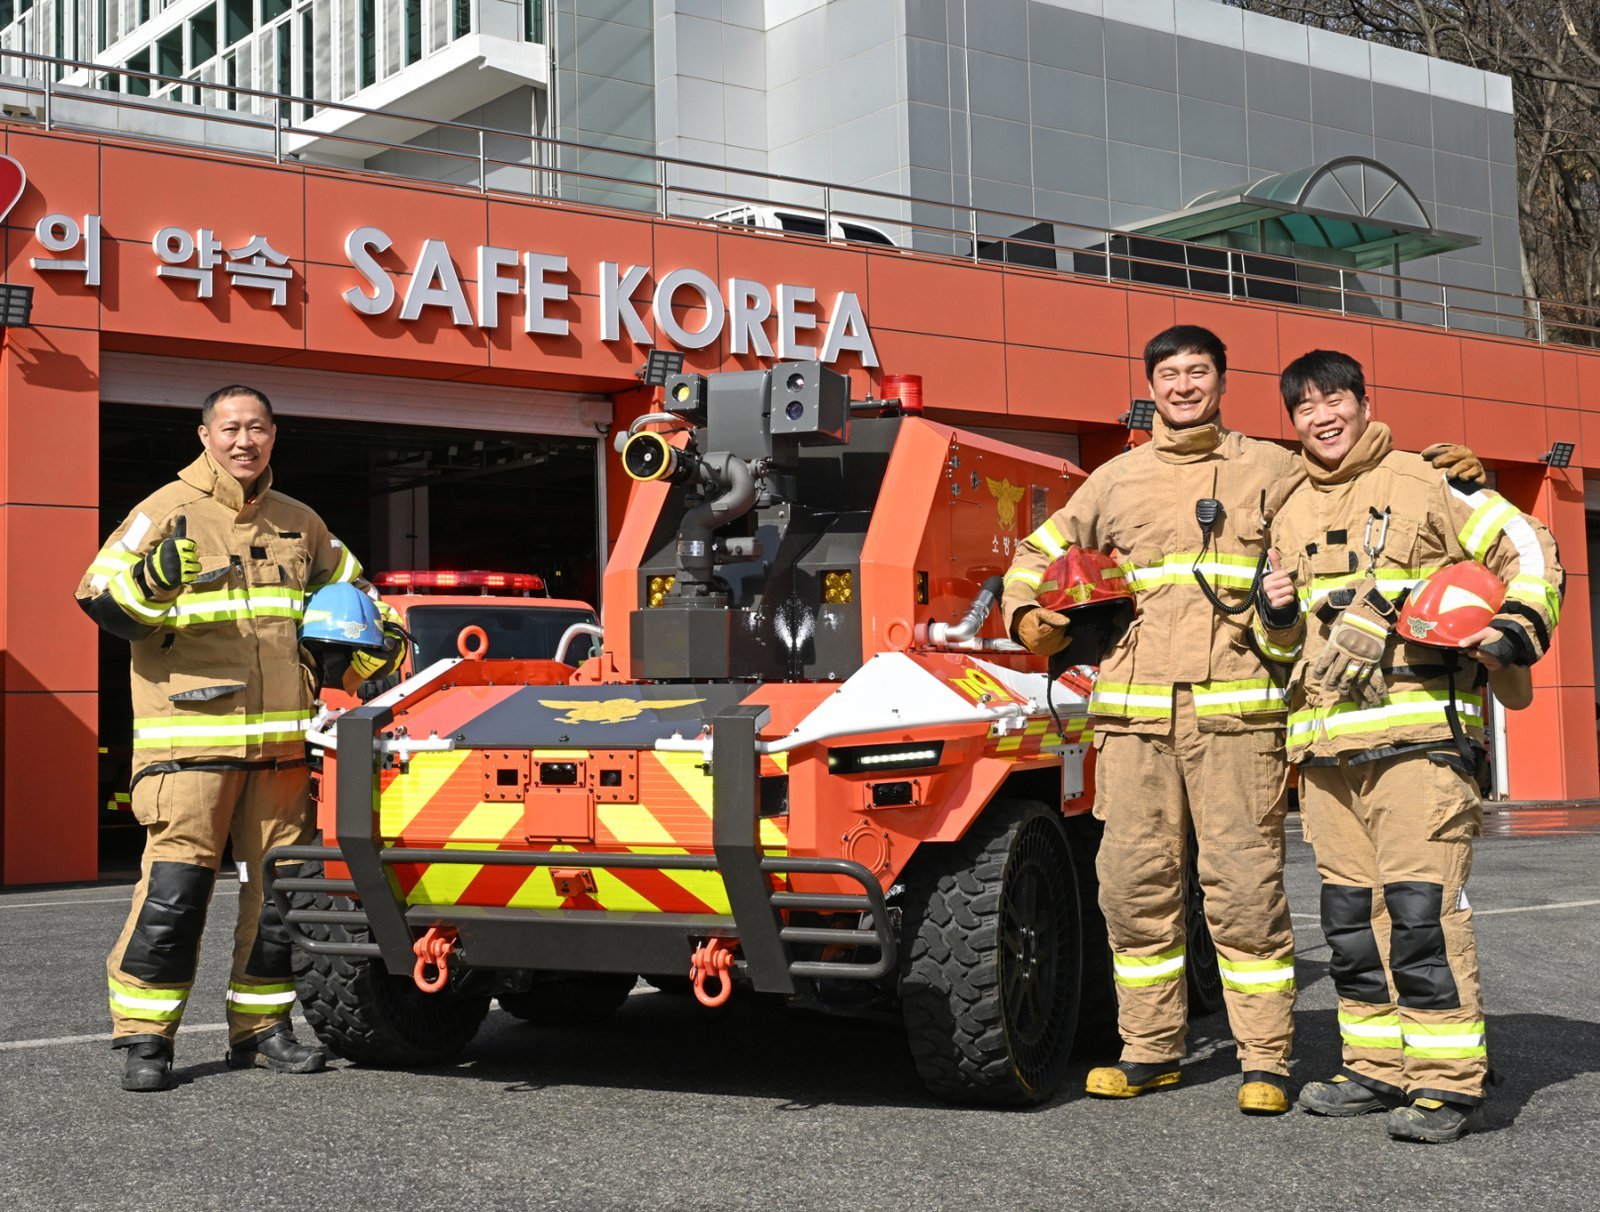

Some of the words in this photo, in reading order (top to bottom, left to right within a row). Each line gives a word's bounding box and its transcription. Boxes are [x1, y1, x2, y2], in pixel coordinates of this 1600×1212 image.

[30, 213, 100, 286] 의
[152, 226, 292, 306] 약속
[342, 226, 569, 336] SAFE
[600, 261, 879, 368] KOREA
